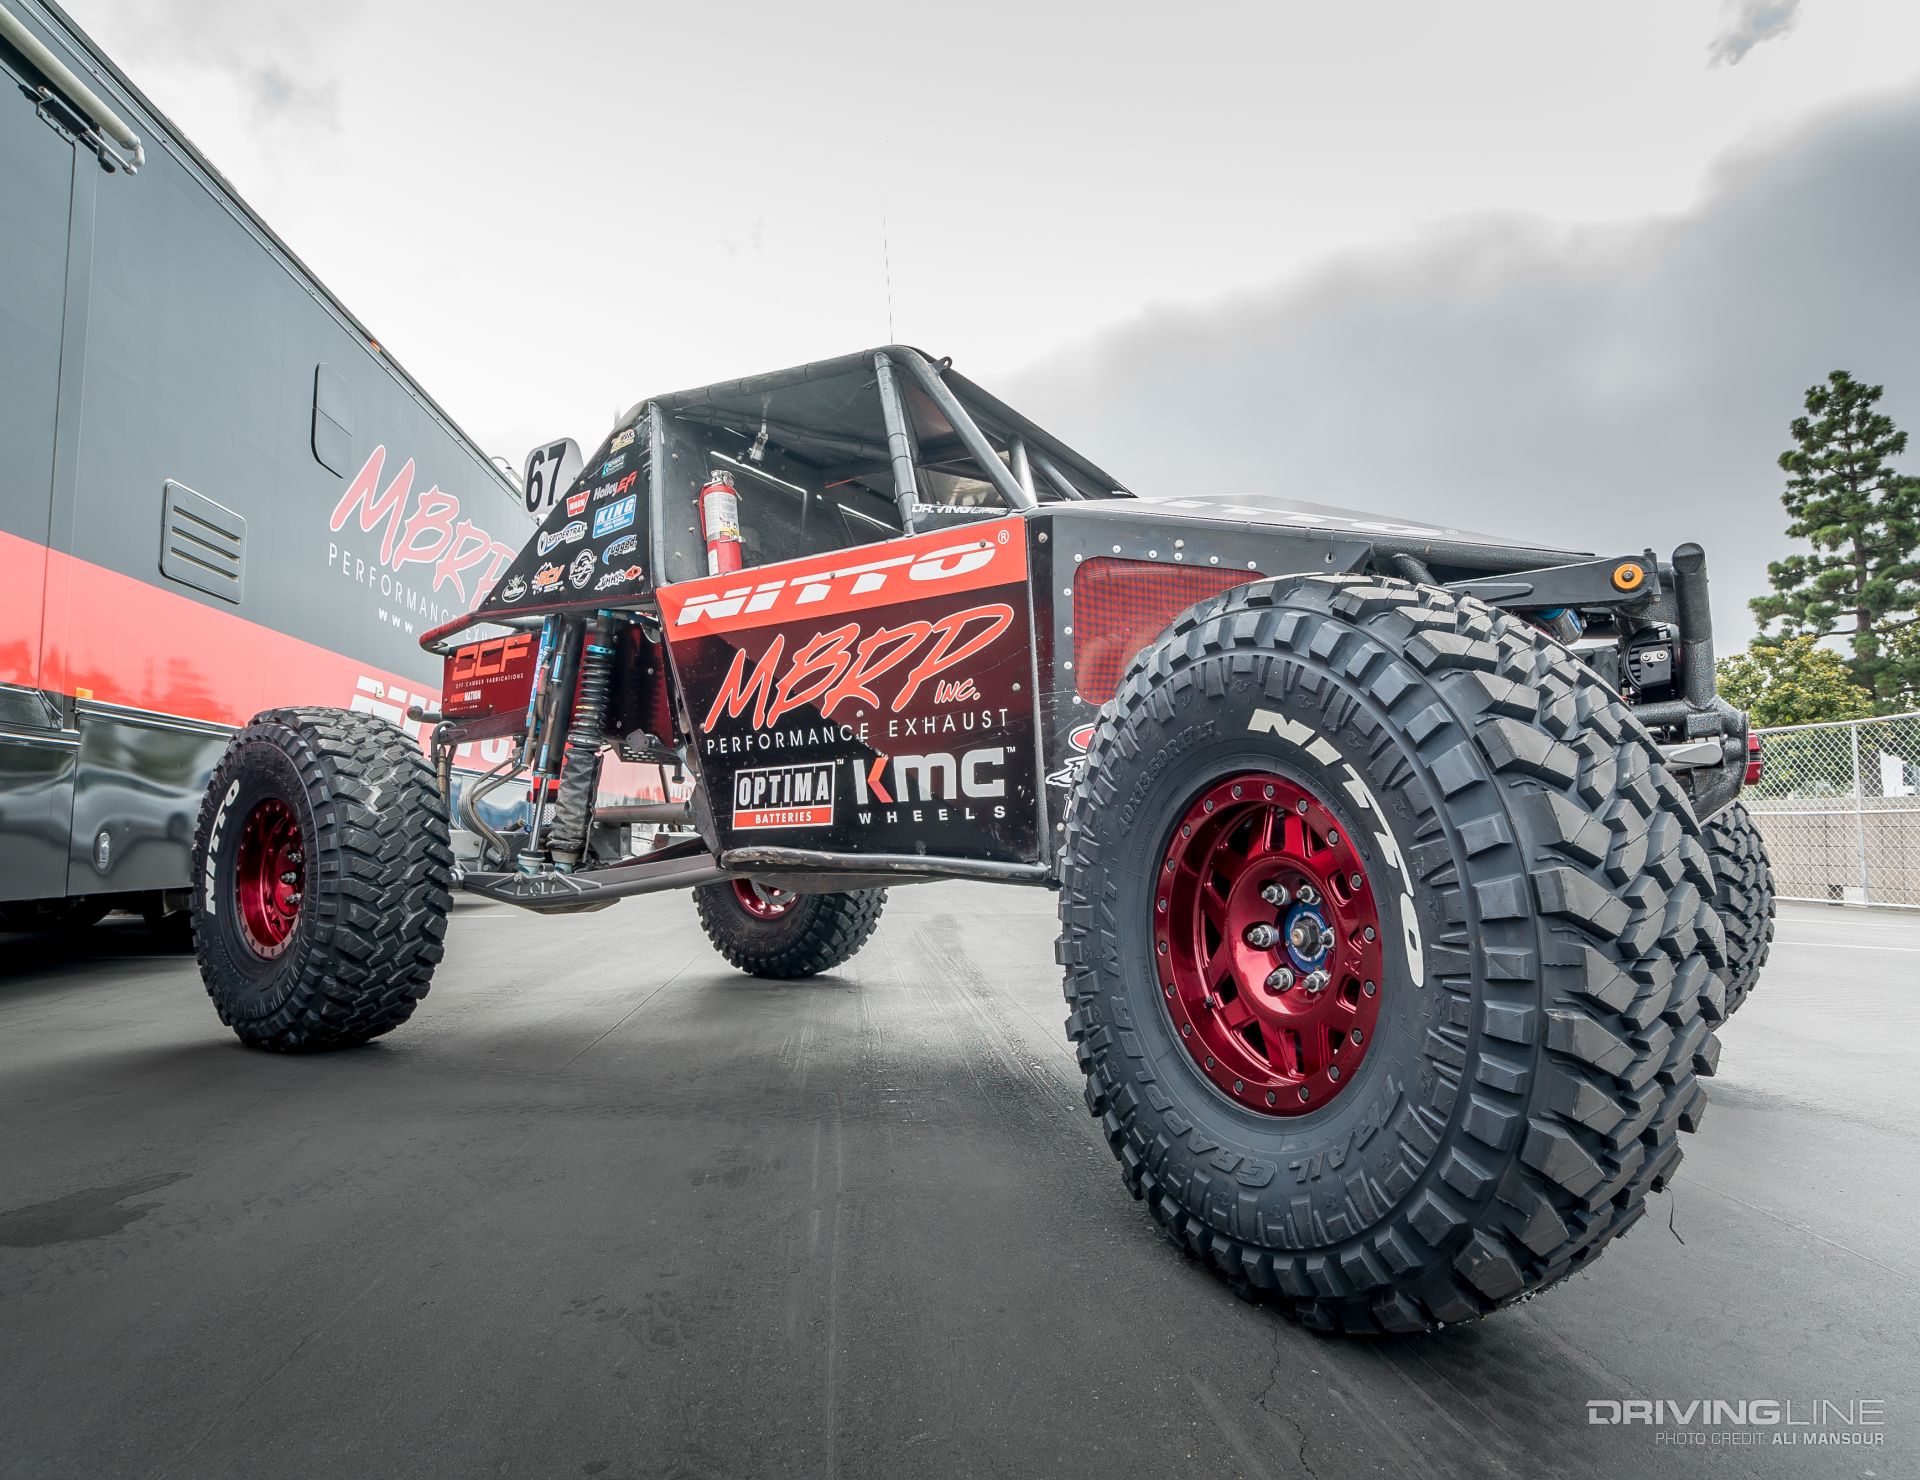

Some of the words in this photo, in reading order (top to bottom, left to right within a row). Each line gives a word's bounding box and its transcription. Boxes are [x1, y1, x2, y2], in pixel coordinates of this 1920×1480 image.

[526, 442, 567, 513] 67
[597, 498, 636, 524] KING
[677, 541, 997, 626] NITTO
[704, 603, 1014, 733] MBRP
[706, 722, 870, 756] PERFORMANCE
[889, 707, 1010, 739] EXHAUST
[738, 769, 831, 808] OPTIMA
[755, 810, 813, 825] BATTERIES
[858, 806, 1007, 826] WHEELS
[205, 778, 240, 916] NITTO
[1247, 708, 1425, 988] NITTO
